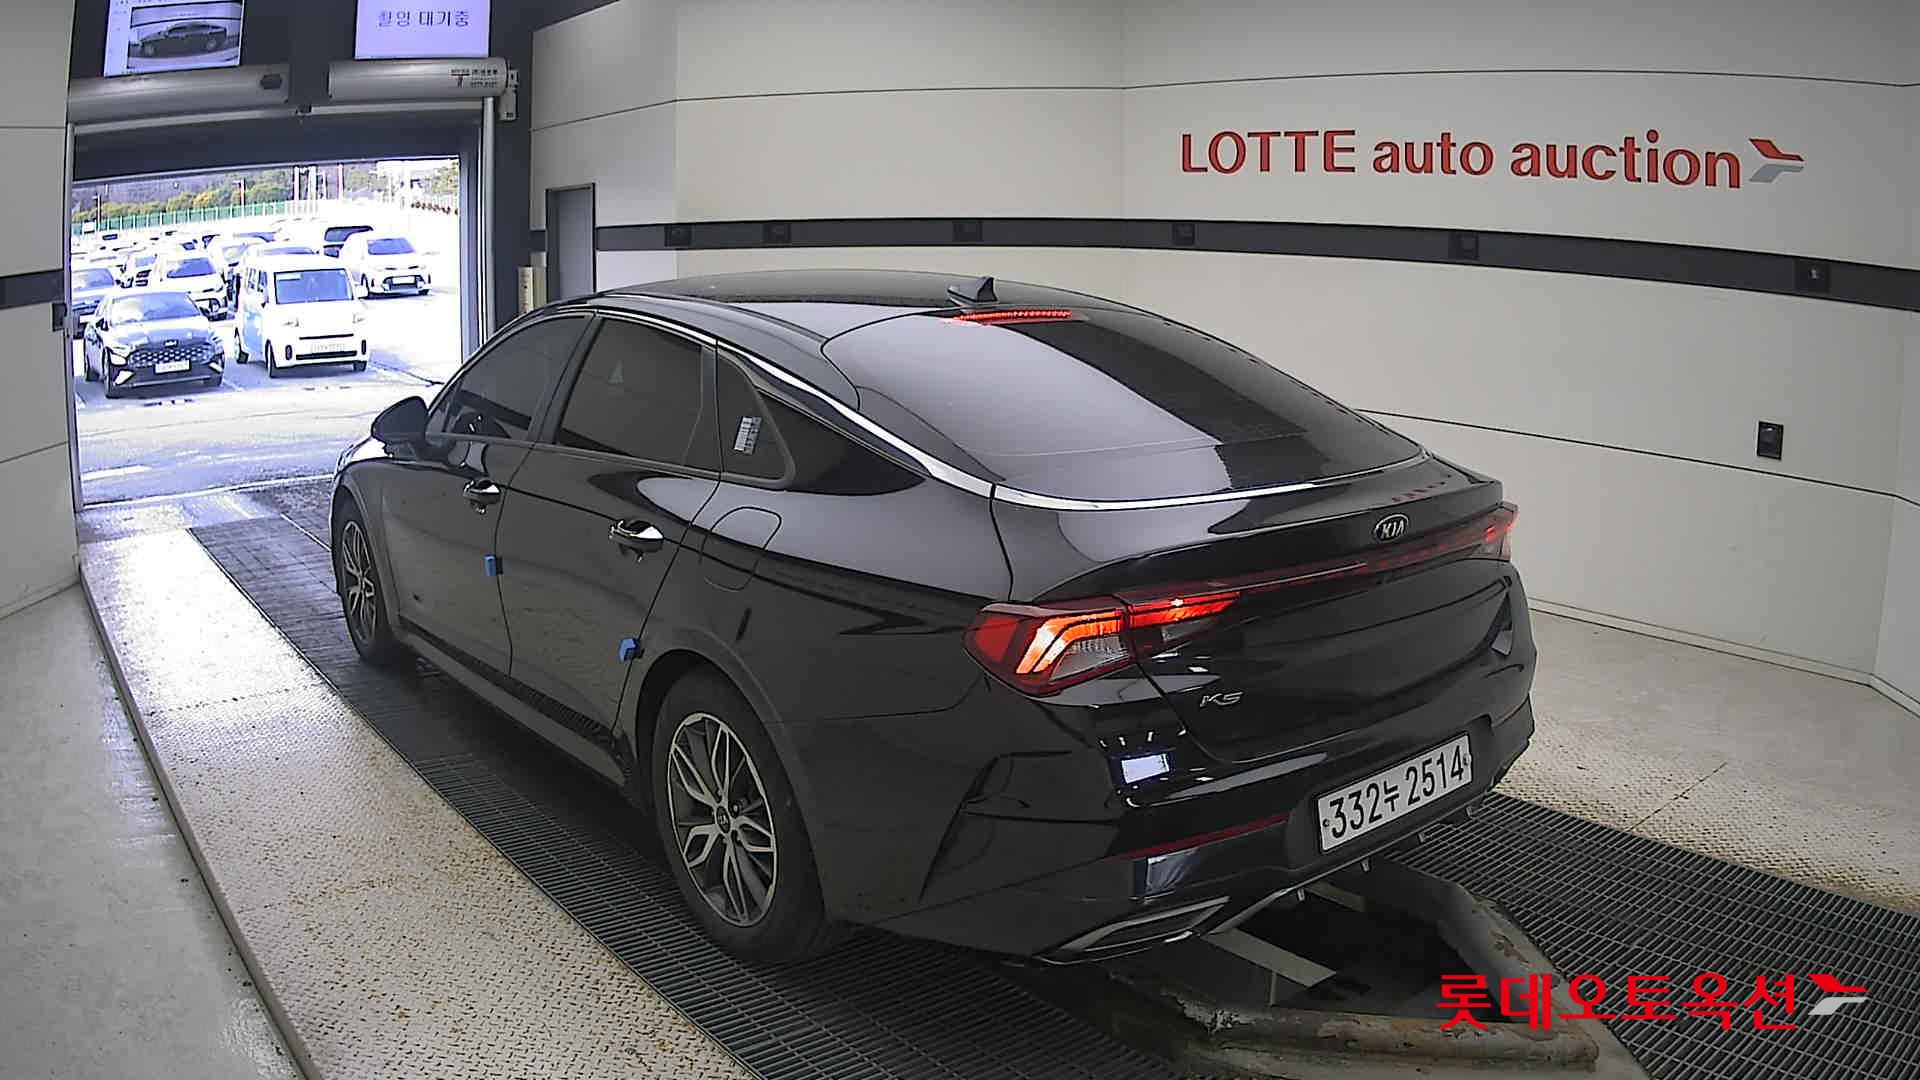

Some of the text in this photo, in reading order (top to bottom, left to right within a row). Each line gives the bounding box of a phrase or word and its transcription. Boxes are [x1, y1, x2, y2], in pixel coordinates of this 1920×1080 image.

[418, 10, 470, 28] 대기중
[1182, 129, 1742, 190] LOTTE auto auction
[1380, 519, 1405, 540] KIA
[1200, 691, 1244, 708] K5
[1404, 744, 1465, 807] 2514
